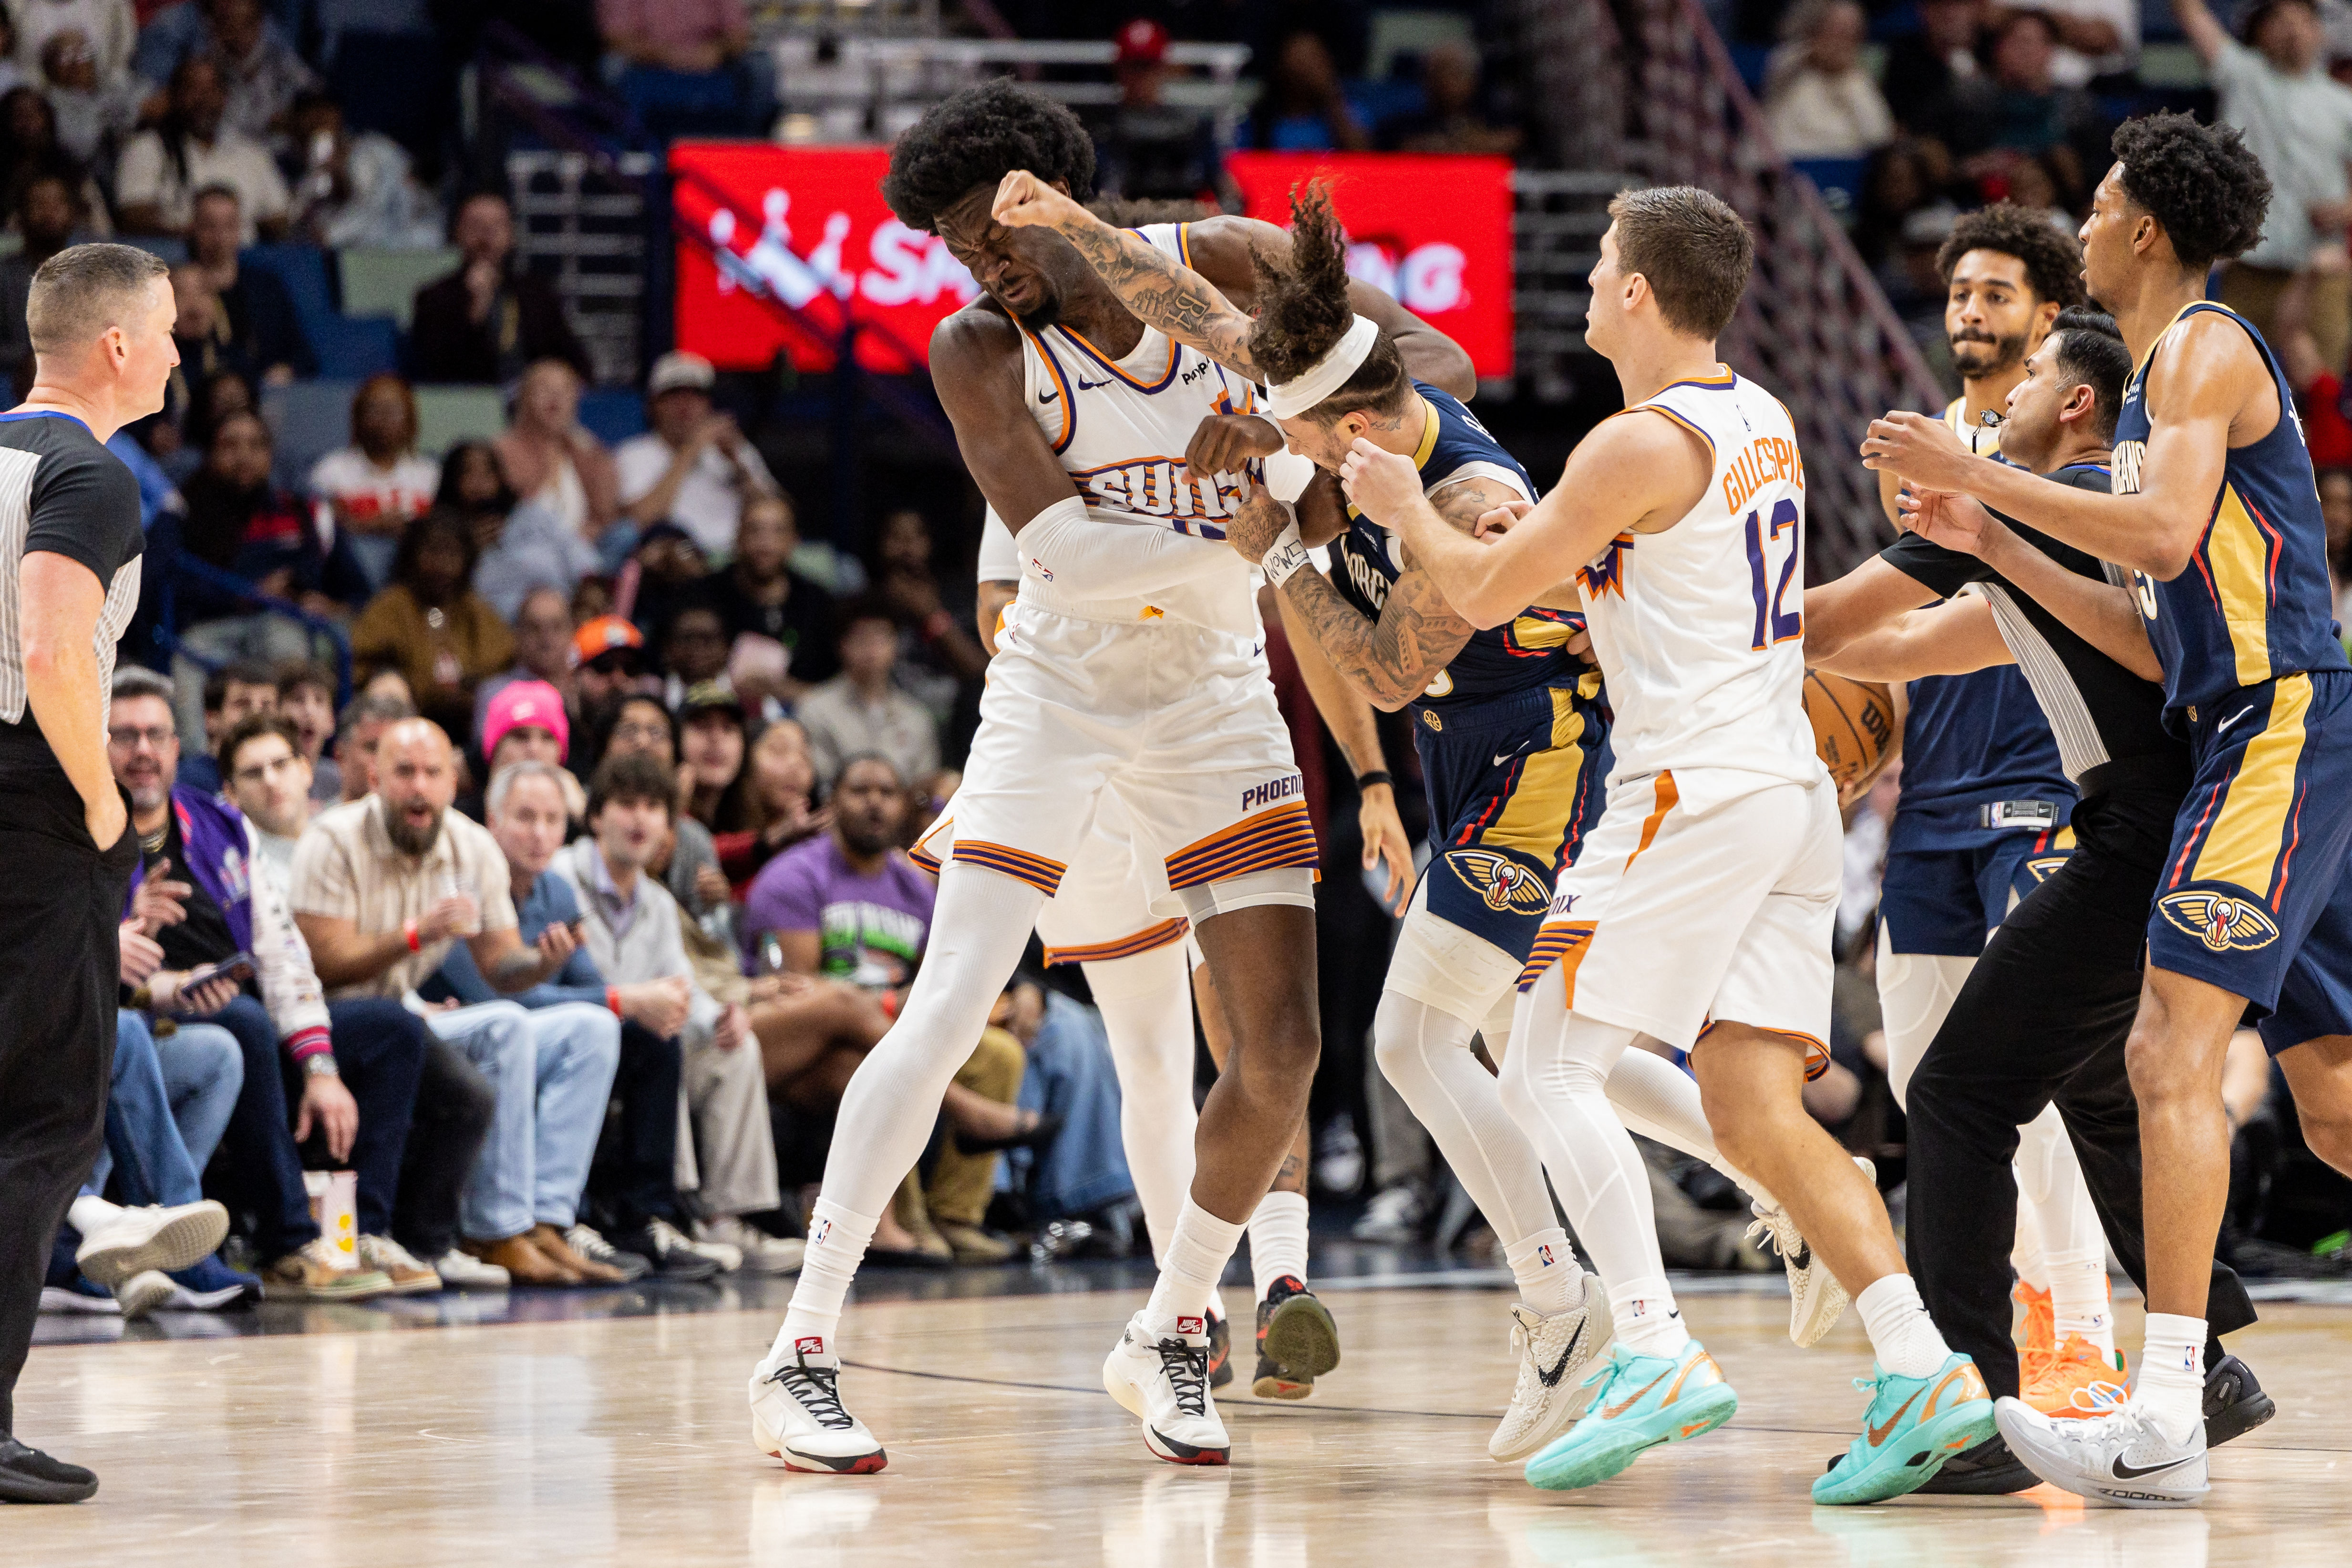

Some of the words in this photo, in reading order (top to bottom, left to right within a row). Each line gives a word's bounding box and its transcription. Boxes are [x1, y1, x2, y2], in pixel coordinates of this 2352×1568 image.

[1723, 437, 1804, 516] GILLESPIE
[1744, 498, 1805, 651] 12
[1242, 774, 1304, 812] PHOENI
[1181, 1319, 1197, 1327] NIKE
